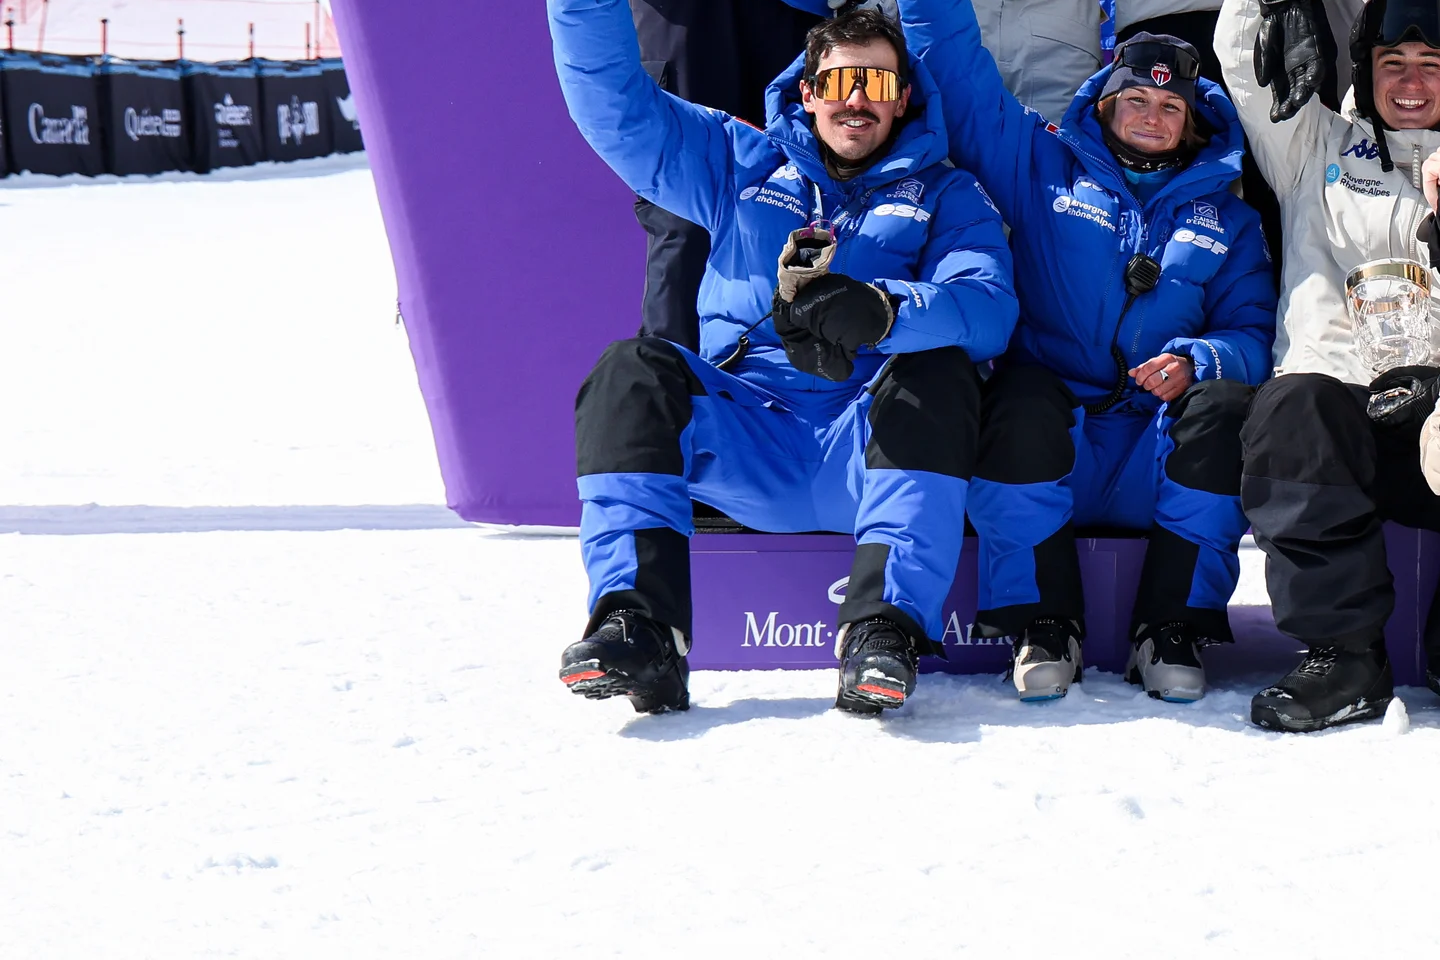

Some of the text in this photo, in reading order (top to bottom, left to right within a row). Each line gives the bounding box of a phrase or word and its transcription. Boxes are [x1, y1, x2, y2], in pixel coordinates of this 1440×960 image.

[1342, 171, 1384, 187] Auvergne-
[1339, 177, 1391, 198] Rhône-Alpes
[1186, 218, 1226, 234] D'EPARGNE
[1193, 215, 1220, 226] CAISSE
